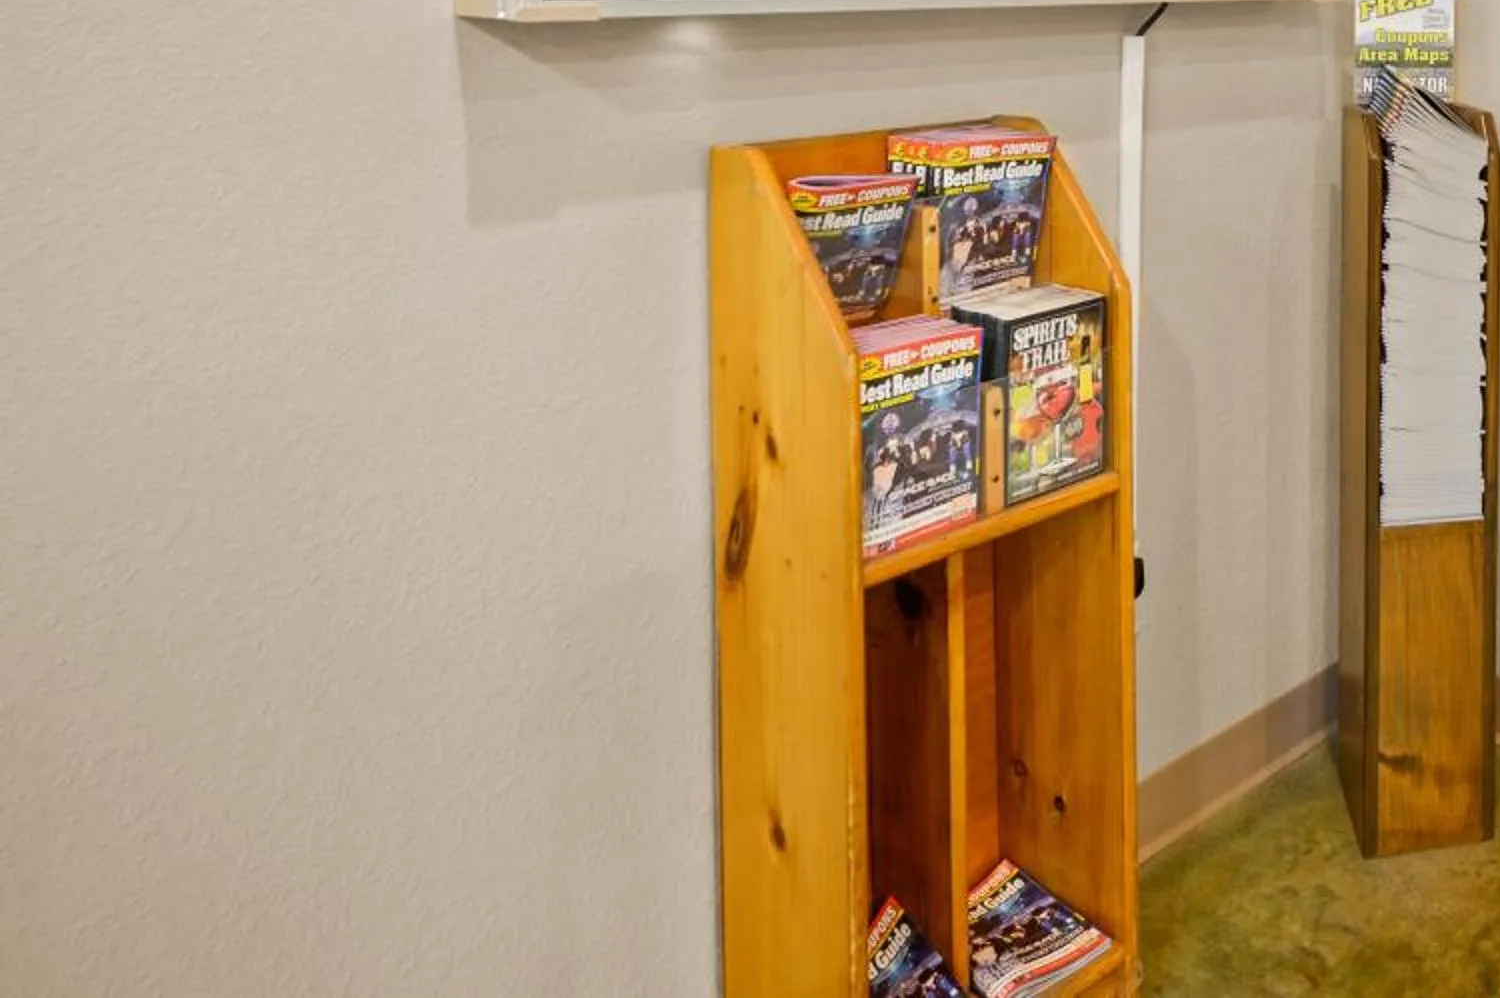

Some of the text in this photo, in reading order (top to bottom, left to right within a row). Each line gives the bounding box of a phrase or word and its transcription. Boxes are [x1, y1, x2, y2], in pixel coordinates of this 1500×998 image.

[1374, 27, 1449, 46] Coupons
[1359, 47, 1449, 65] Area Maps
[943, 158, 1043, 188] Best Read Guide
[823, 209, 860, 231] Read
[861, 202, 904, 227] Guide
[1012, 313, 1079, 352] SPIRITS
[892, 368, 929, 397] Read
[931, 357, 974, 384] Guide
[984, 877, 1026, 914] Guide
[875, 923, 912, 972] Guide
